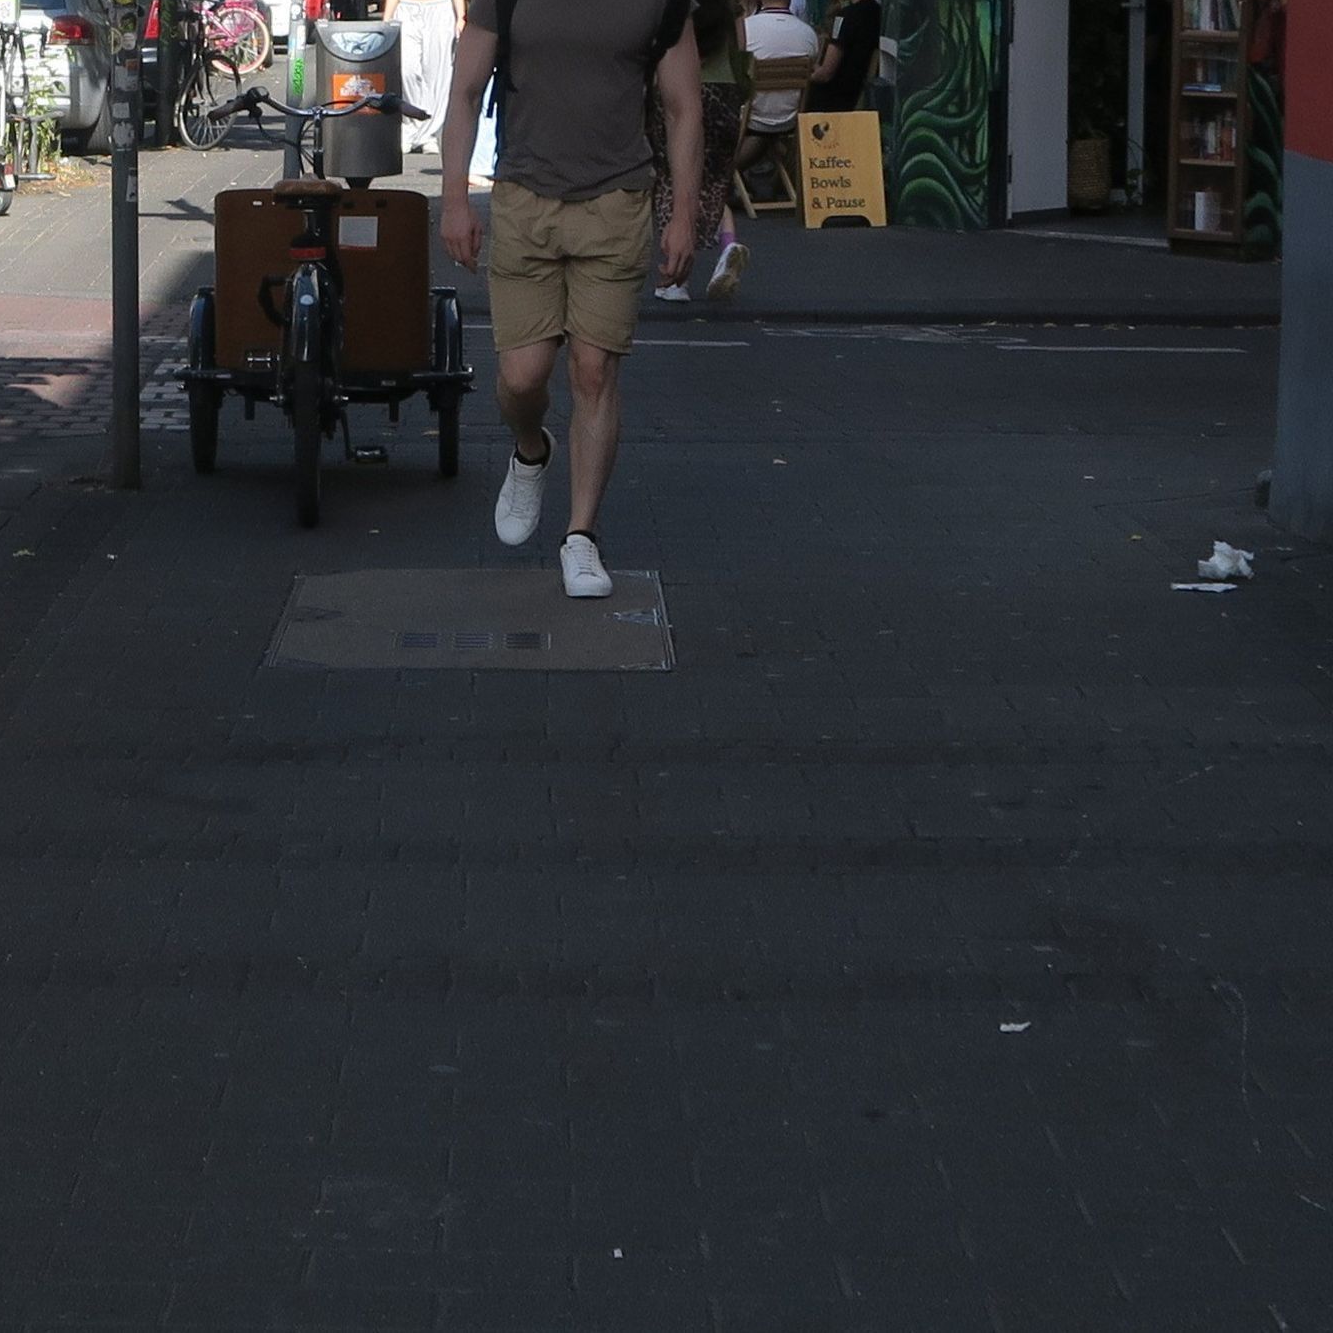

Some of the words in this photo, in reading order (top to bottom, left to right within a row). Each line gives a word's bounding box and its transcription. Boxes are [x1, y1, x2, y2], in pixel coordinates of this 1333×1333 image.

[810, 176, 852, 189] Bowls
[811, 197, 823, 209] &
[826, 197, 866, 209] Pause
